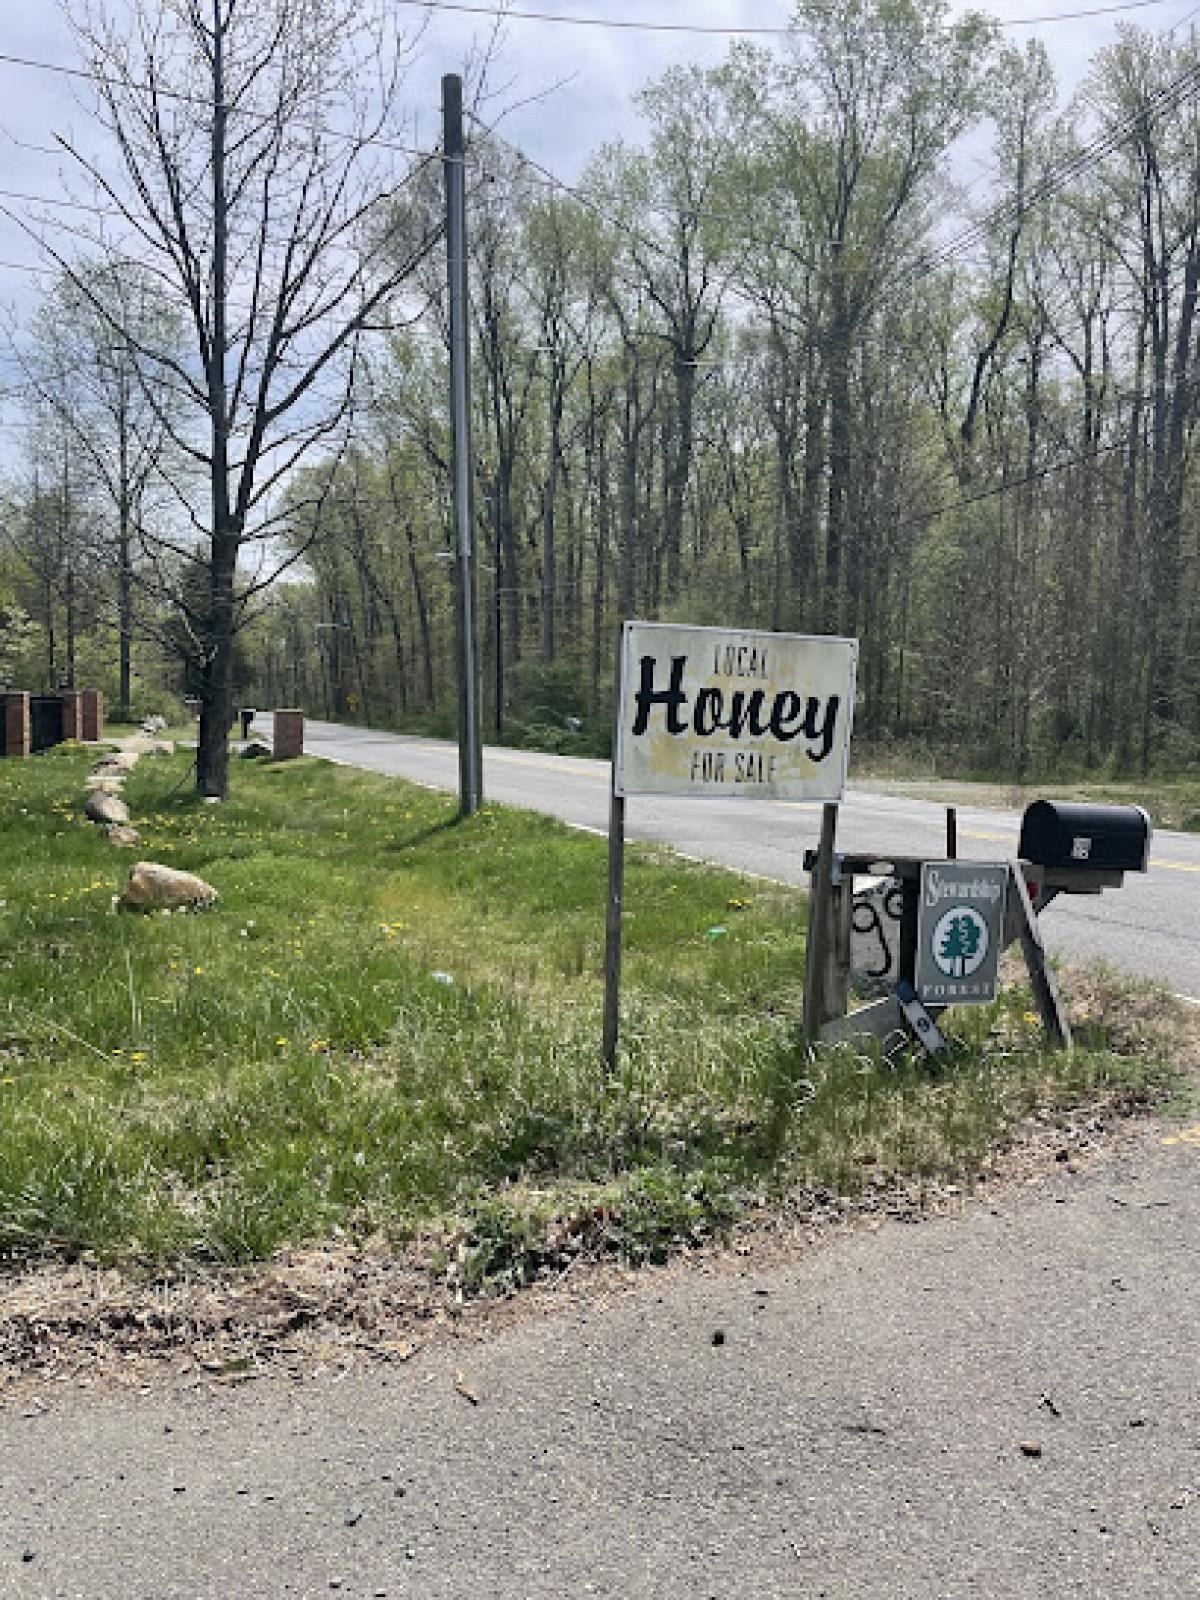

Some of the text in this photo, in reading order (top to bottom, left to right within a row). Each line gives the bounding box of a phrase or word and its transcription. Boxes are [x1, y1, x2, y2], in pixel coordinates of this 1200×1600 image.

[714, 643, 768, 680] LOCAL
[632, 655, 842, 763] Honey
[690, 752, 777, 784] FOR SALE
